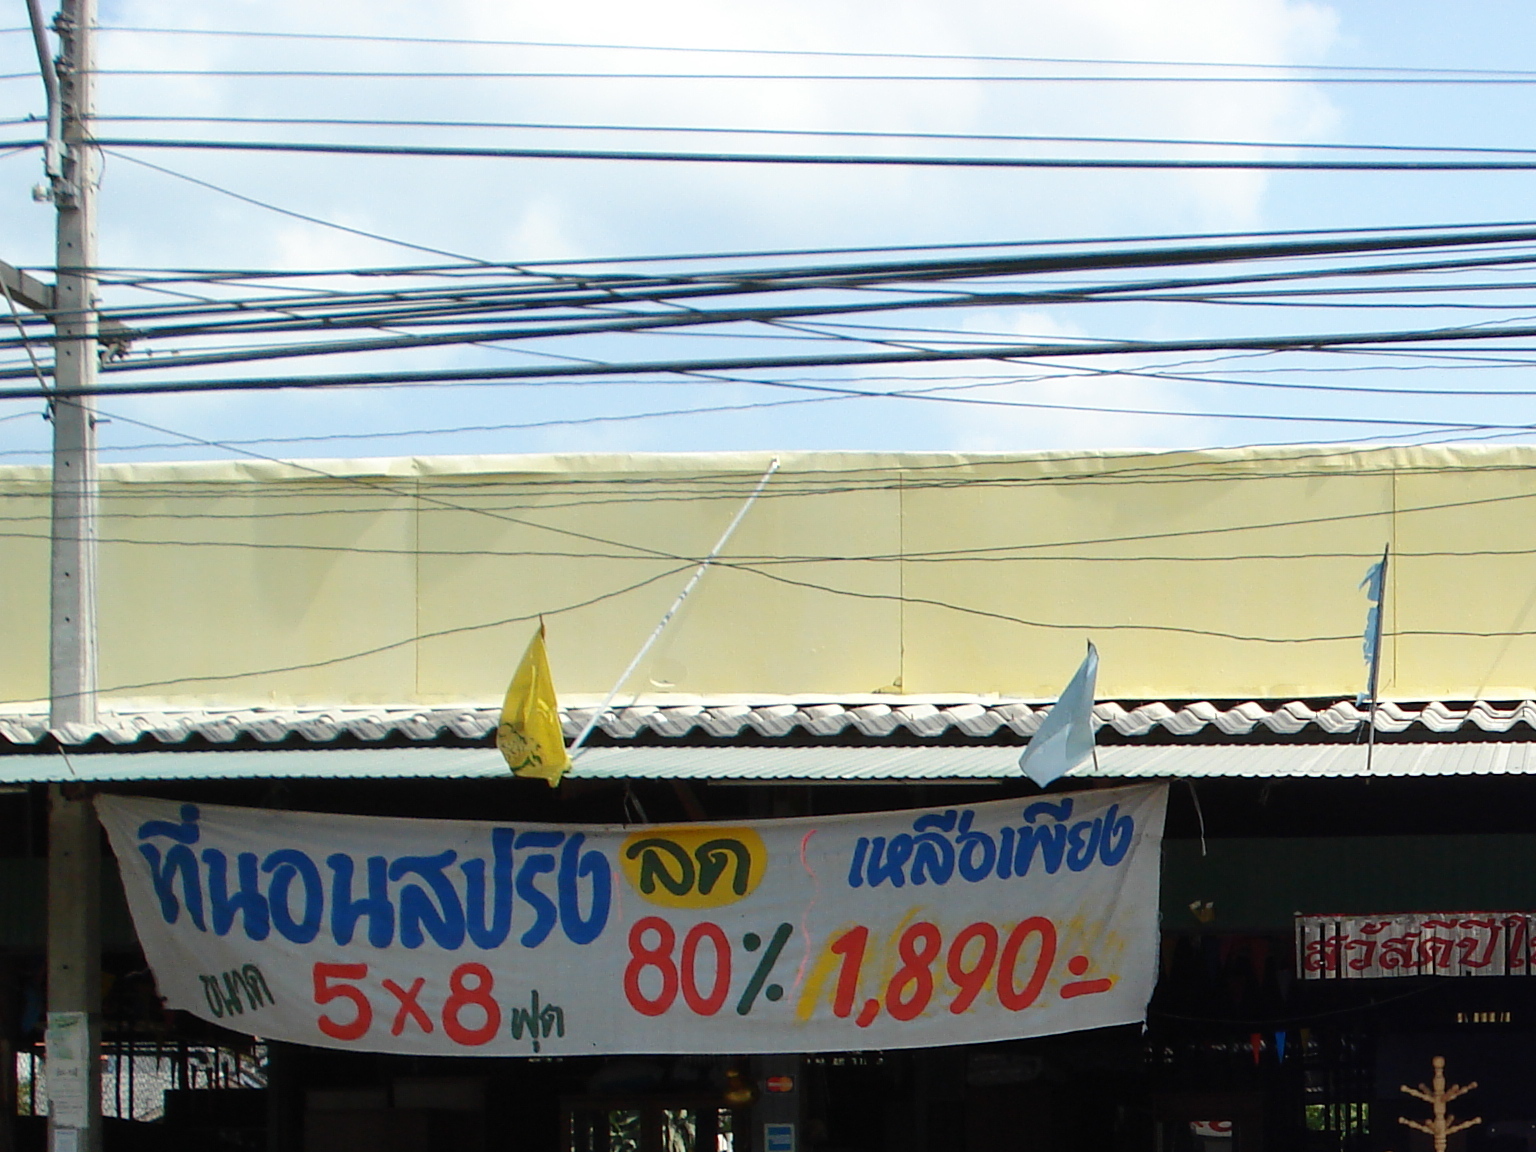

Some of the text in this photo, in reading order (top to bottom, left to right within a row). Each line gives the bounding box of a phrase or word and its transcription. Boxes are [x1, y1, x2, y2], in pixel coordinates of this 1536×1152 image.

[138, 804, 611, 950] ที่นอนสปริง
[626, 838, 752, 897] ลด
[848, 797, 1135, 888] เหลือเพียง
[200, 963, 275, 1018] ขนาด
[511, 989, 565, 1053] ฟุต
[624, 916, 794, 1017] 80%
